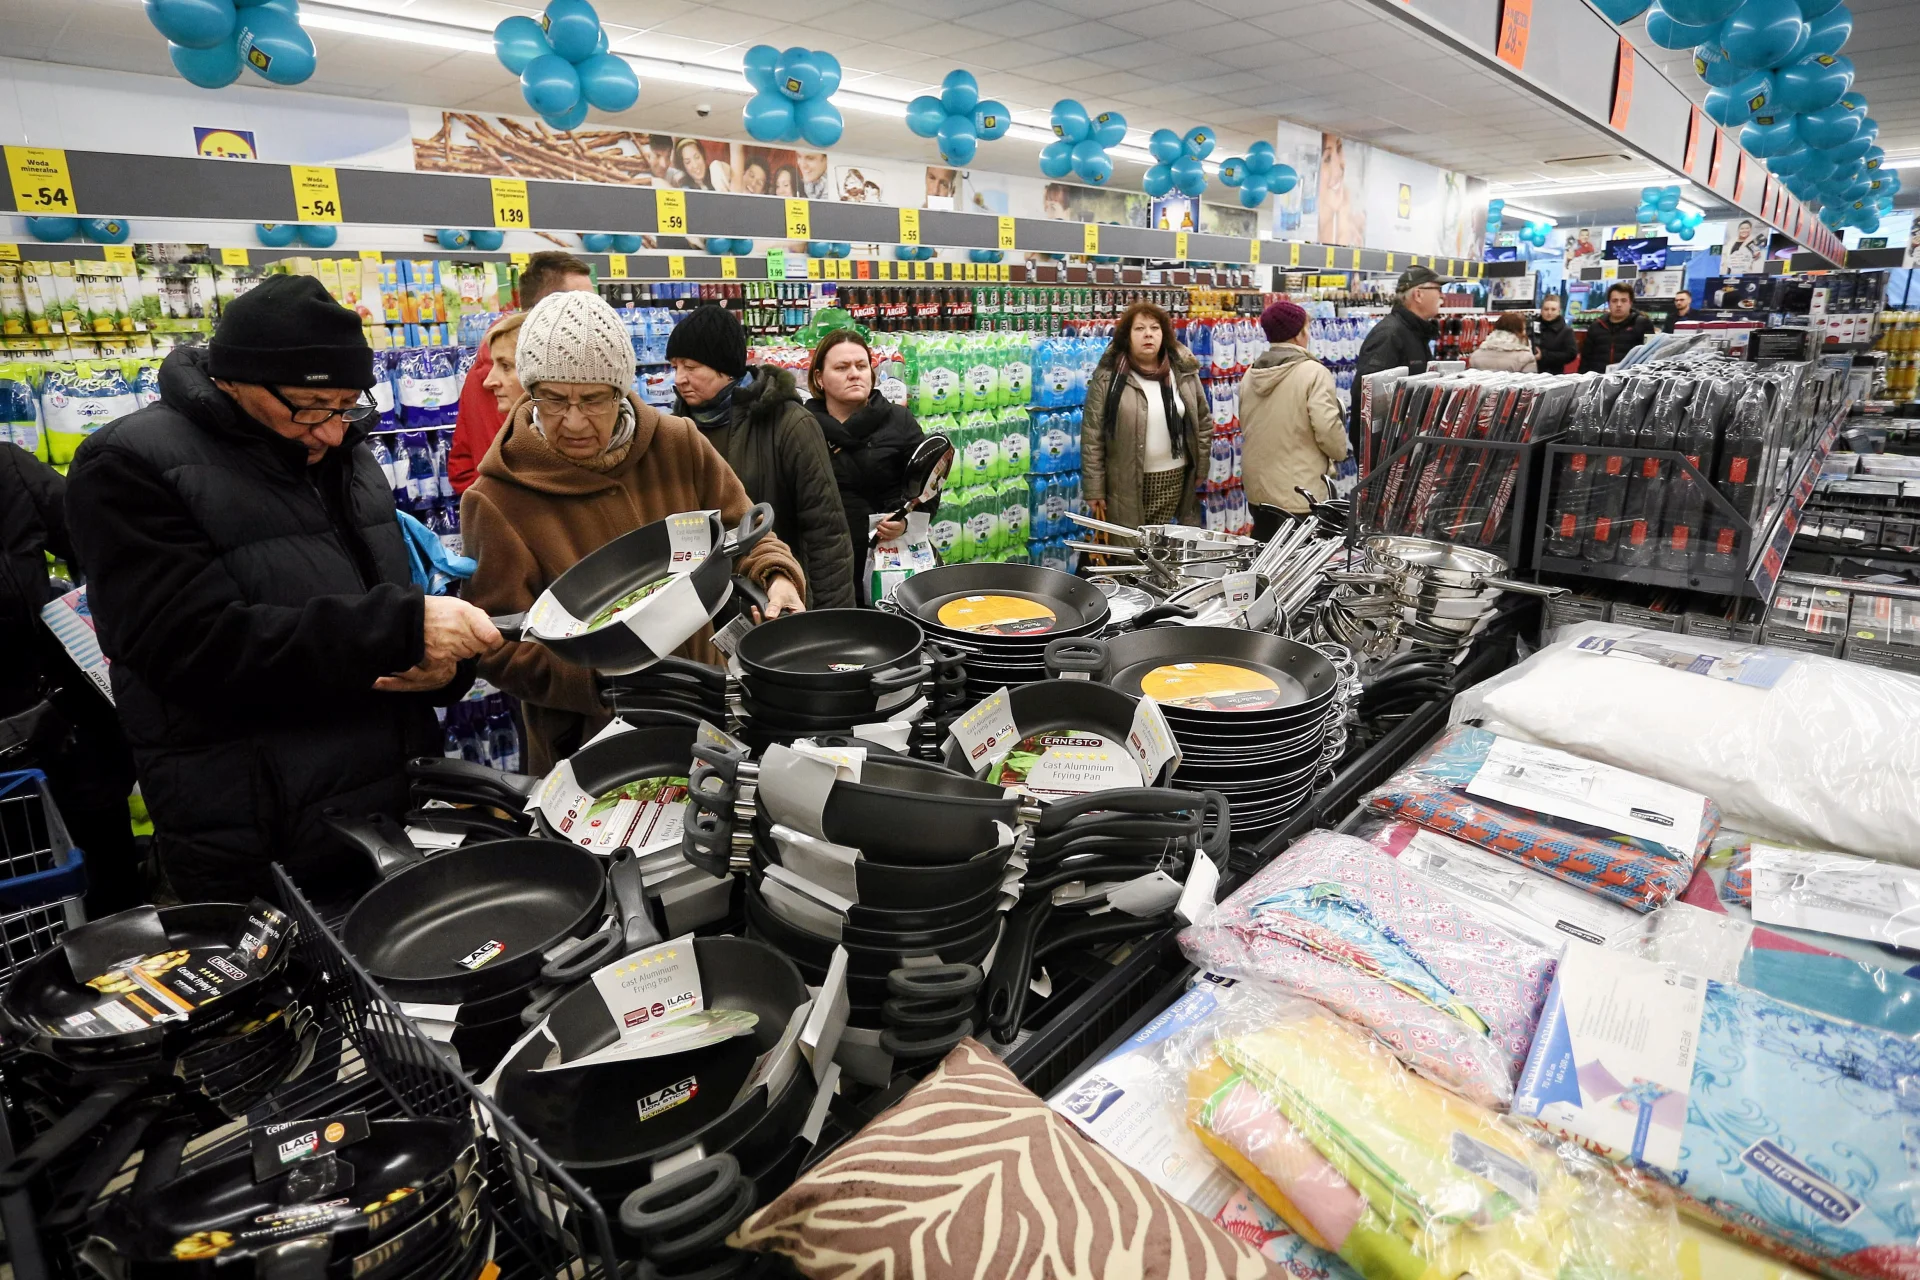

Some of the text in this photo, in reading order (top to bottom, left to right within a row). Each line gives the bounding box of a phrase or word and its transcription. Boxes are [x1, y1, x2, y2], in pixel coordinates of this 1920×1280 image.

[27, 159, 49, 167] Woda
[21, 187, 69, 206] -.54
[302, 200, 336, 216] -.54
[500, 208, 524, 222] 1.39
[662, 216, 682, 228] -.59
[790, 223, 807, 234] -.59
[770, 268, 783, 277] 3.99
[853, 307, 876, 317] ARGUS
[886, 306, 907, 316] ARGUS
[917, 307, 938, 316] ARGUS
[952, 306, 973, 315] ARGUS
[878, 546, 898, 554] Persil
[1044, 737, 1100, 746] ERNESTO
[1043, 761, 1114, 772] Cast Aluminium
[1053, 771, 1101, 782] Frying Pan
[1631, 811, 1673, 827] meradiso
[243, 933, 260, 946] ILAG
[1558, 923, 1602, 944] meradiso
[211, 957, 243, 979] ERNESTO
[177, 966, 220, 996] Ceramic Frying Pan
[621, 964, 679, 989] Cast Aluminium
[633, 975, 673, 994] Frying Pan
[667, 991, 693, 1006] ILAG
[1135, 1009, 1175, 1044] NORMALNY
[1524, 1044, 1546, 1093] NORMALNY
[640, 1079, 693, 1109] ILAG
[641, 1089, 689, 1113] NON STICK
[642, 1102, 679, 1120] ULTIMATE
[281, 1133, 315, 1154] ILAG
[1752, 1151, 1847, 1217] meradiso
[241, 1224, 293, 1238] Ceramic
